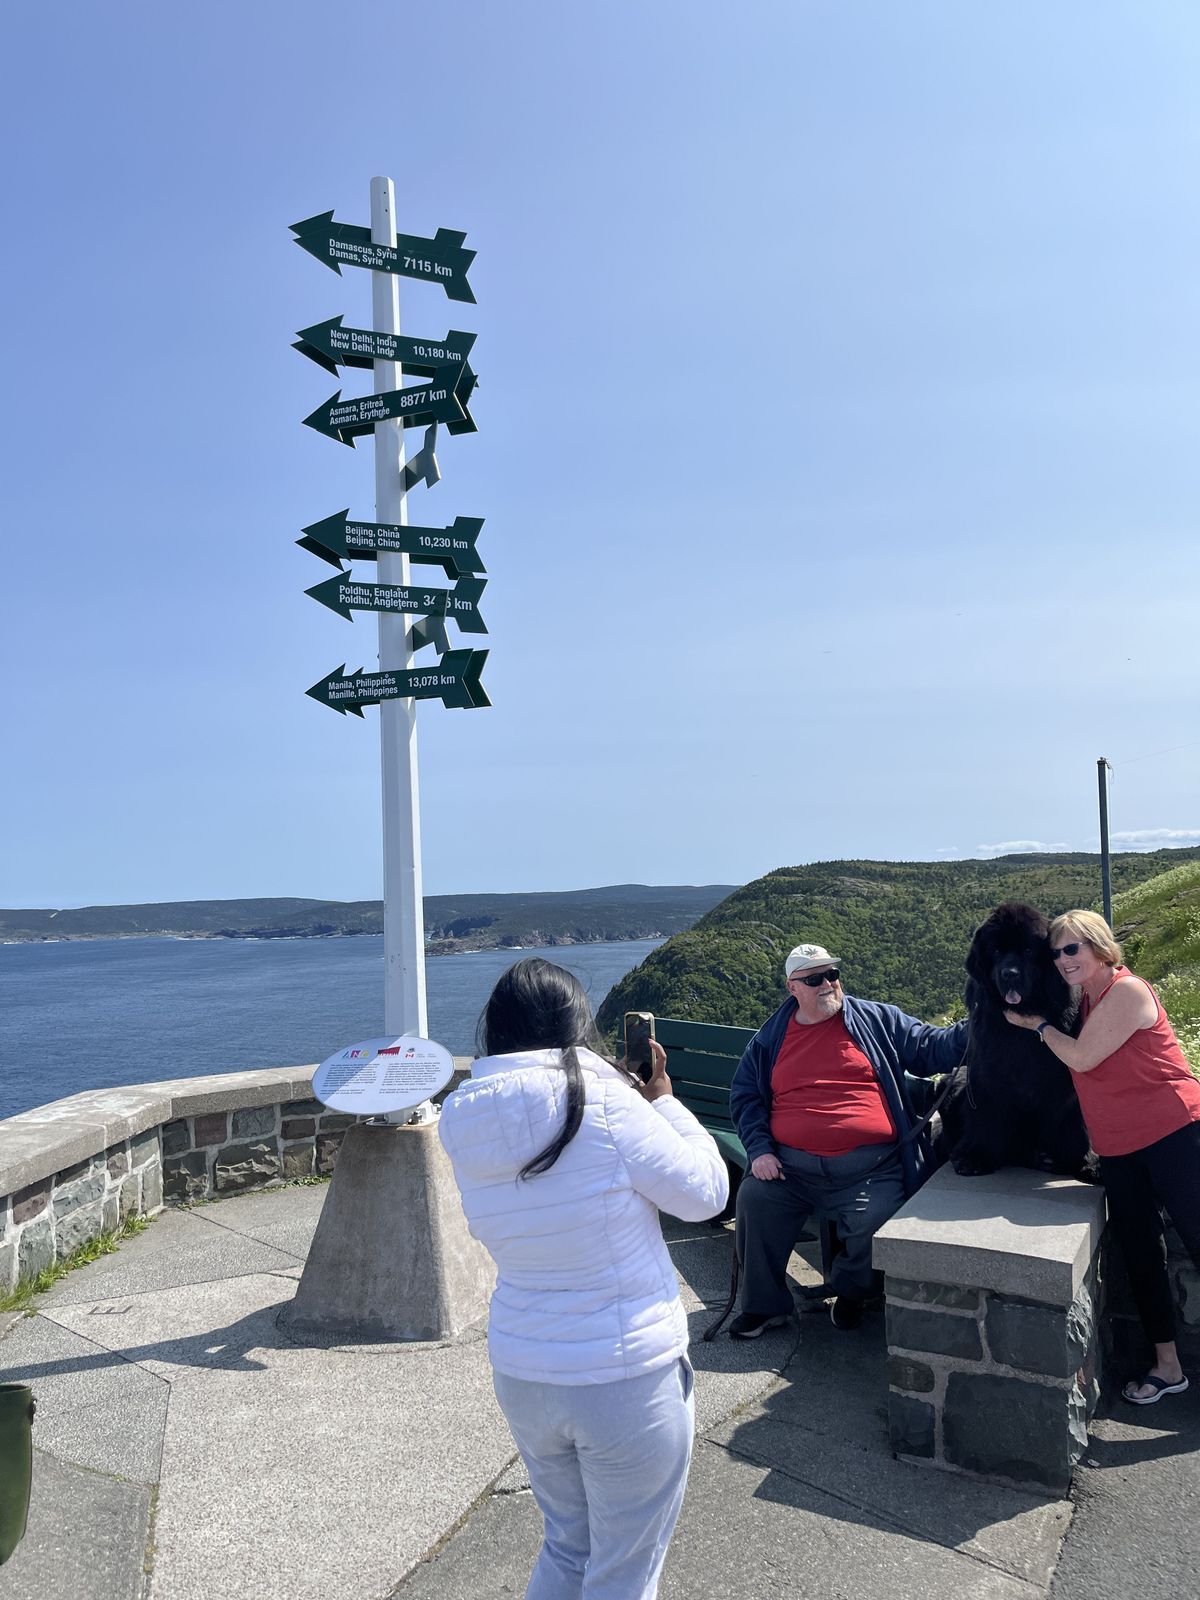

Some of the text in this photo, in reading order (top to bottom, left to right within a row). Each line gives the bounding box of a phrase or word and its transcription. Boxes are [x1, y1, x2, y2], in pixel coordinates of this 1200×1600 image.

[330, 238, 397, 260] Damascus, Syria
[330, 248, 383, 266] Damas, Syrie
[403, 256, 452, 277] 7115 km
[330, 330, 397, 347] New Delhi, India
[330, 339, 349, 349] New
[352, 342, 375, 354] Delhi,
[413, 346, 462, 360] 10,180 km
[400, 389, 447, 407] 8877 km
[330, 400, 383, 416] Asmara, Eritrea
[330, 414, 359, 425] Asmara,
[346, 526, 400, 539] Beijing, China
[346, 535, 400, 548] Beijing, Chine
[419, 536, 468, 548] 10,230 km
[339, 585, 408, 600] Poldhu, England
[339, 595, 418, 609] Poldhu, Angleterre
[455, 598, 472, 610] km
[329, 677, 396, 691] Manila, Philippines
[408, 675, 455, 688] 13,078 km
[329, 686, 398, 700] Manille, Philippines
